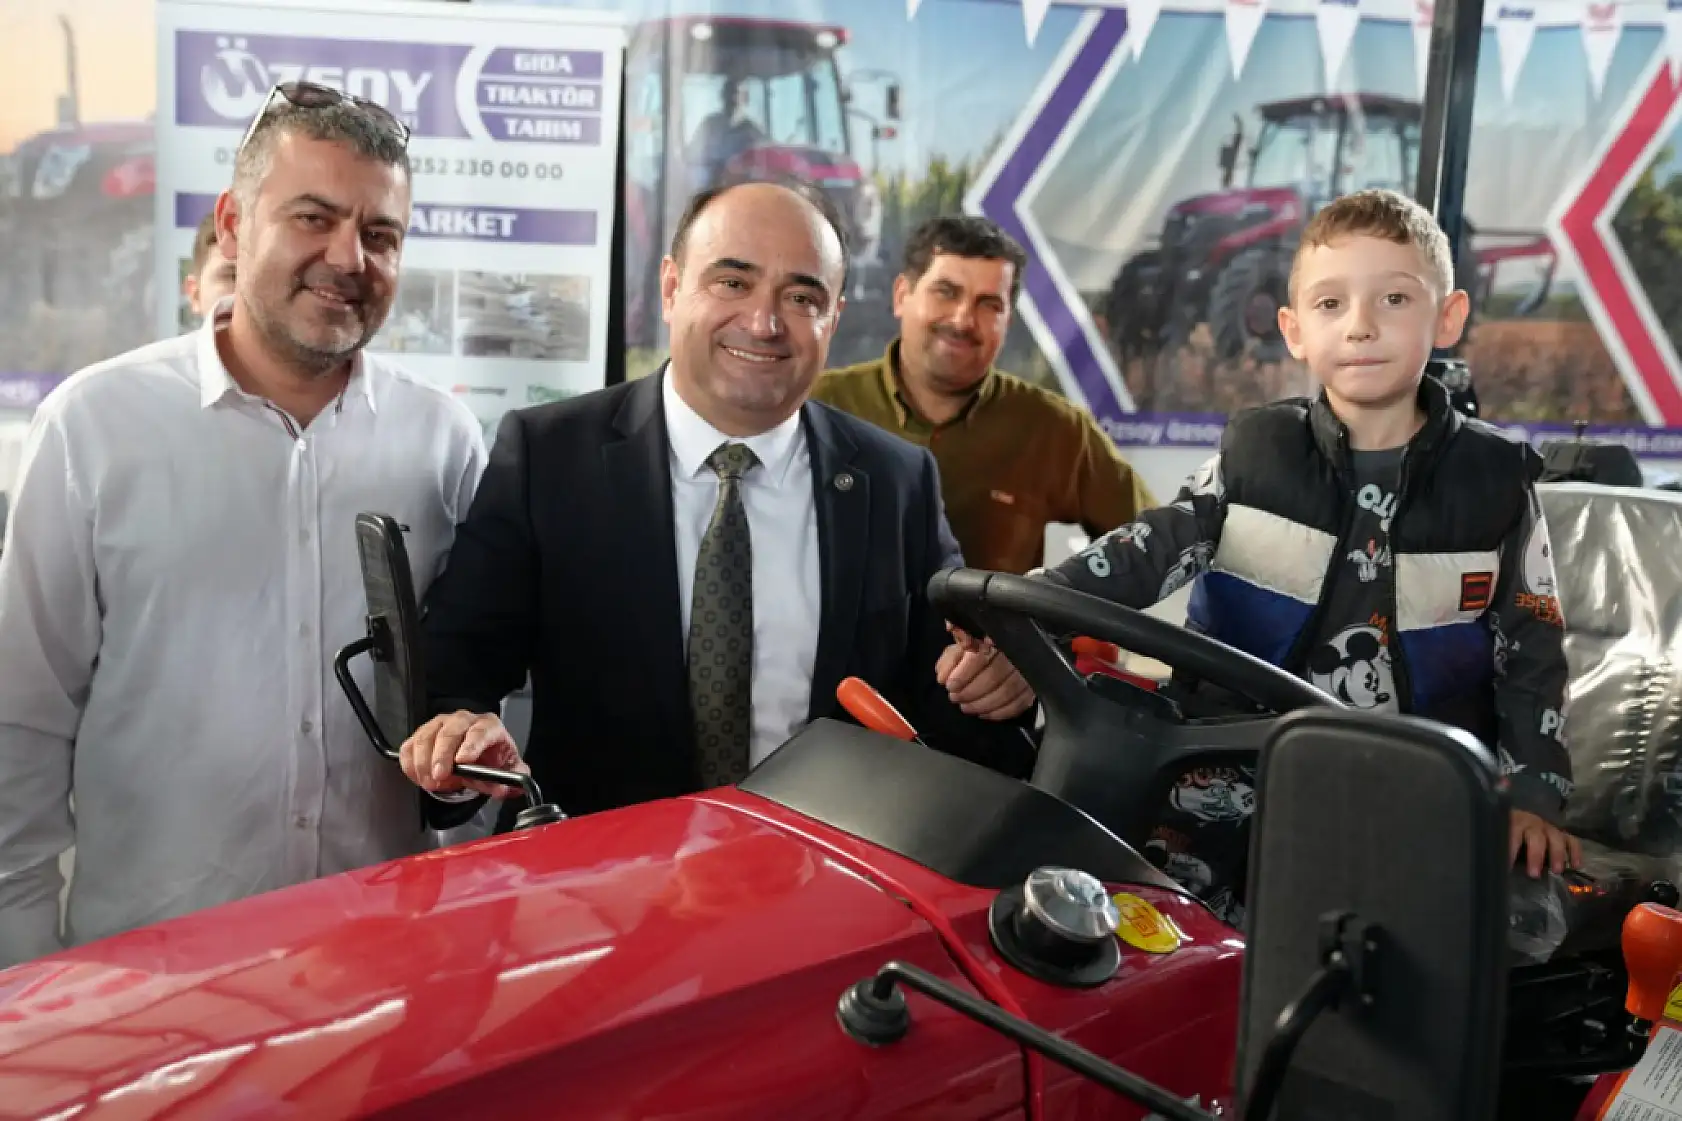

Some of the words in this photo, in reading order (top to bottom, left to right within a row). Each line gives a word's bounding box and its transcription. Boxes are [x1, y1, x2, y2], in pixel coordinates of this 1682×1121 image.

[513, 53, 573, 73] GIDA
[484, 84, 596, 107] TRAKTÖR
[504, 118, 582, 139] TARIM
[455, 159, 494, 177] 230
[500, 160, 529, 179] 00
[535, 163, 563, 180] 00
